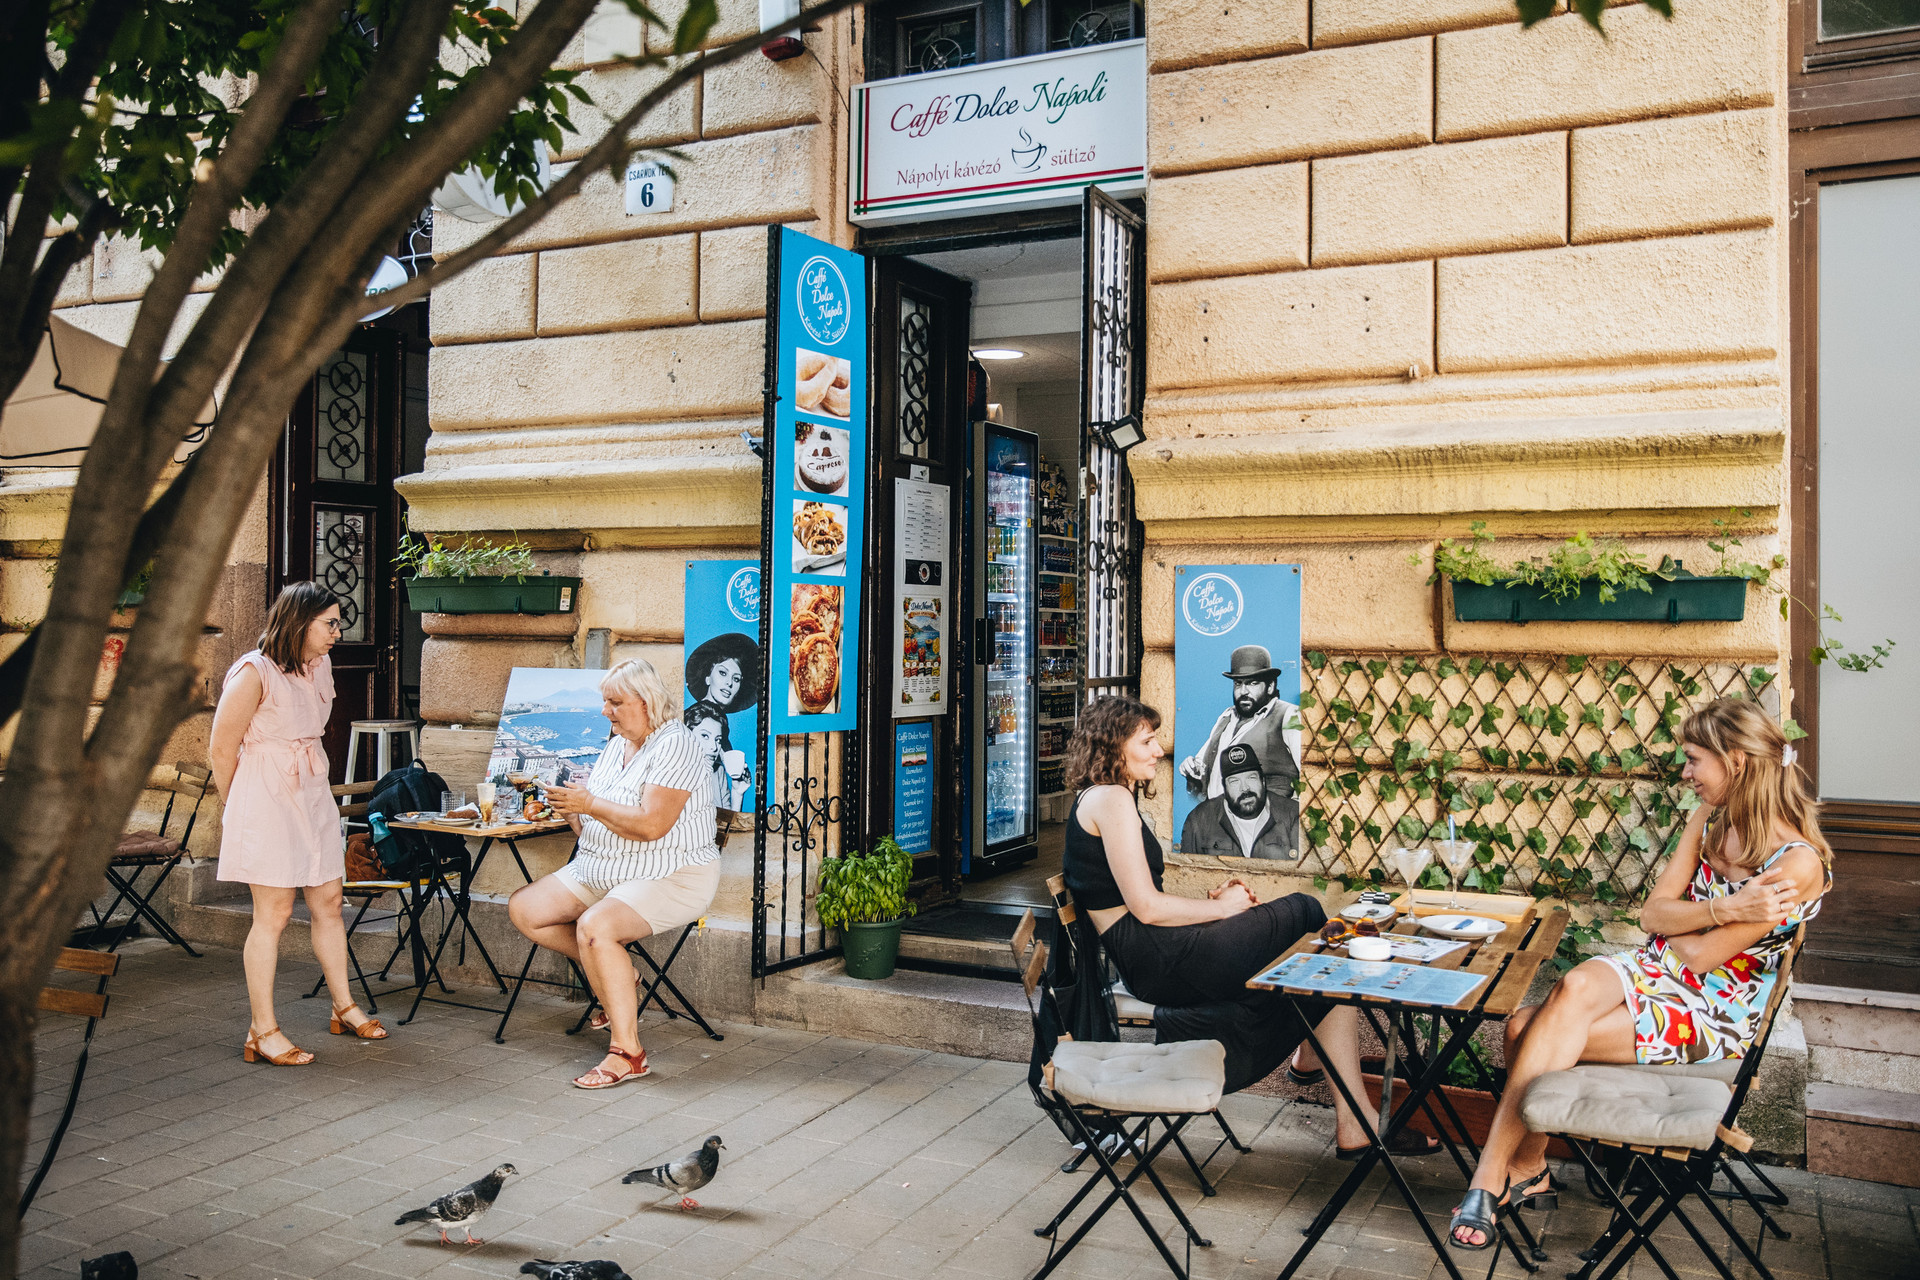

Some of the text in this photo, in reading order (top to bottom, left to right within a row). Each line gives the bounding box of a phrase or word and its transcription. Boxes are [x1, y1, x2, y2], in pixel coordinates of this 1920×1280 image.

[890, 71, 1109, 138] Caffé Dolce Napoli
[629, 168, 656, 181] CSARNOK
[897, 145, 1096, 189] Nápolyi kávézó sütiző
[641, 183, 654, 207] 6
[812, 286, 834, 304] Dolce
[817, 300, 843, 326] Napoli
[738, 585, 758, 599] Dolce
[1198, 593, 1224, 609] Dolce
[1204, 600, 1234, 622] Napoli
